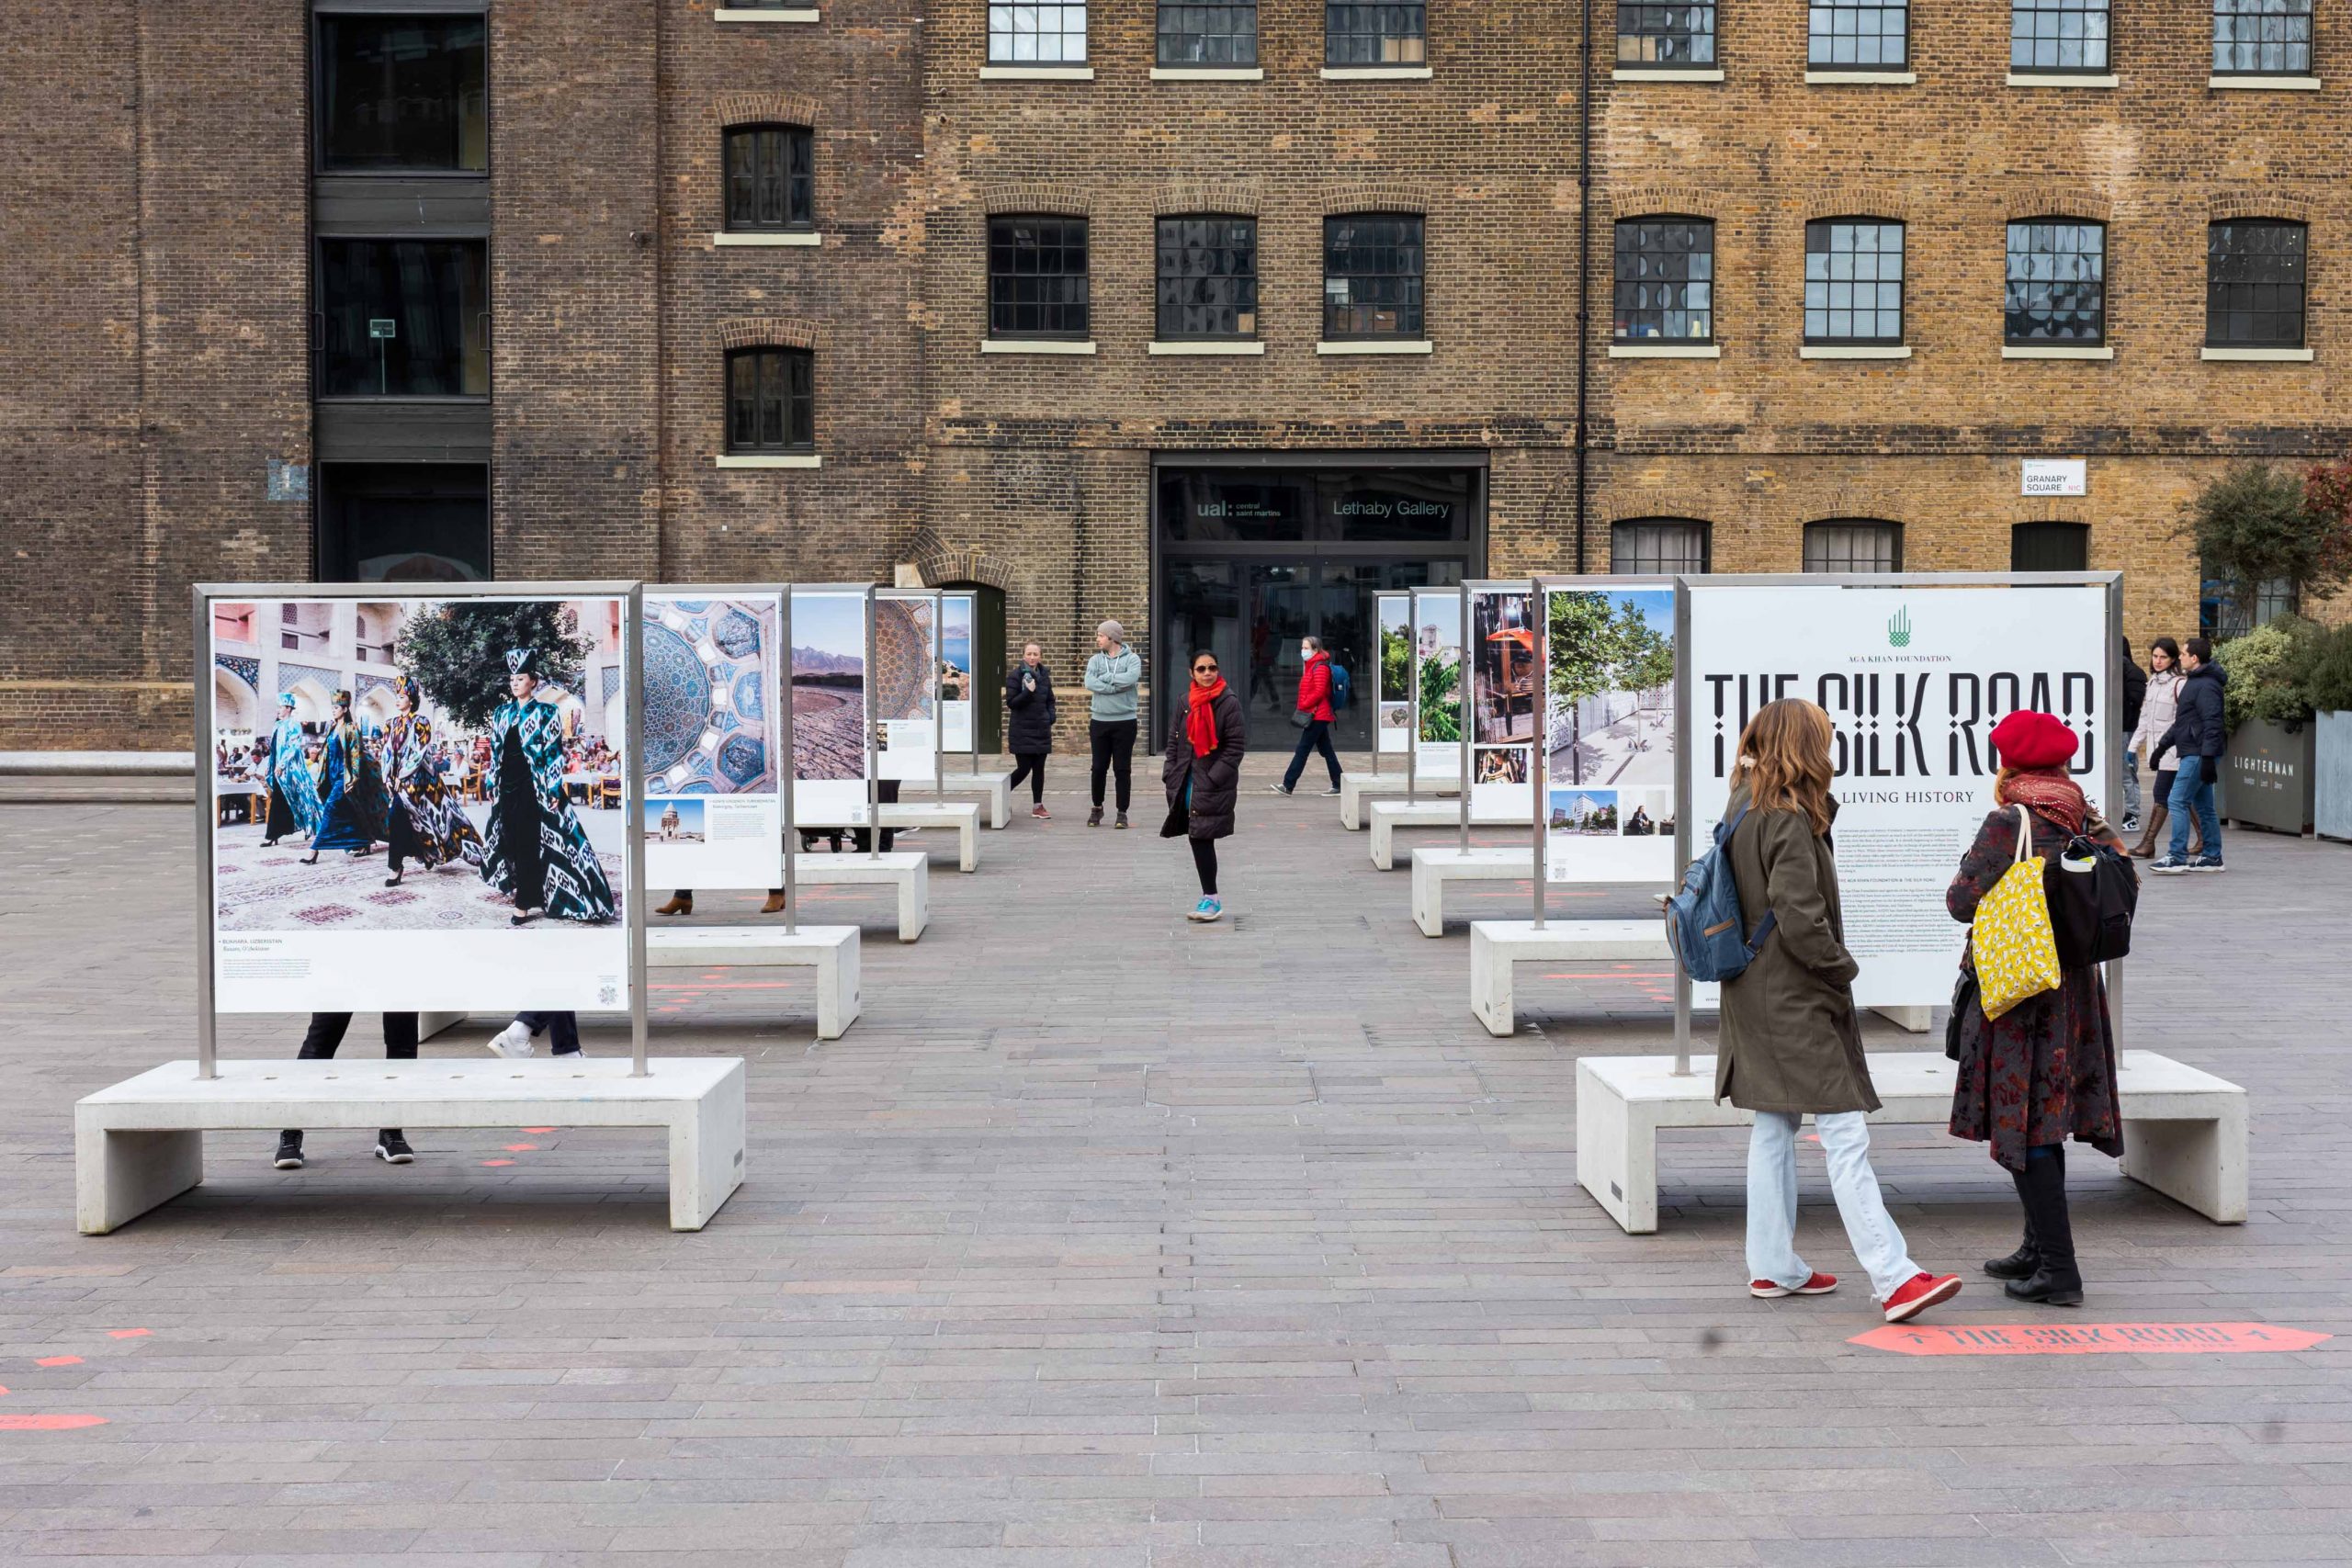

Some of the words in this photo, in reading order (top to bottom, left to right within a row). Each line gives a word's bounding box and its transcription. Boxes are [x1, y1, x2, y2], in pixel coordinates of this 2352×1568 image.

[1333, 501, 1393, 518] Lethaby
[1396, 501, 1450, 518] Gallery
[1817, 672, 1931, 777] SILK
[2234, 756, 2294, 777] LIGHTERMAN
[1842, 792, 1899, 804] LIVING
[1905, 791, 1974, 803] HISTORY
[1939, 1330, 2022, 1345] THE
[2023, 1328, 2117, 1344] SILK
[2115, 1327, 2234, 1342] ROAD
